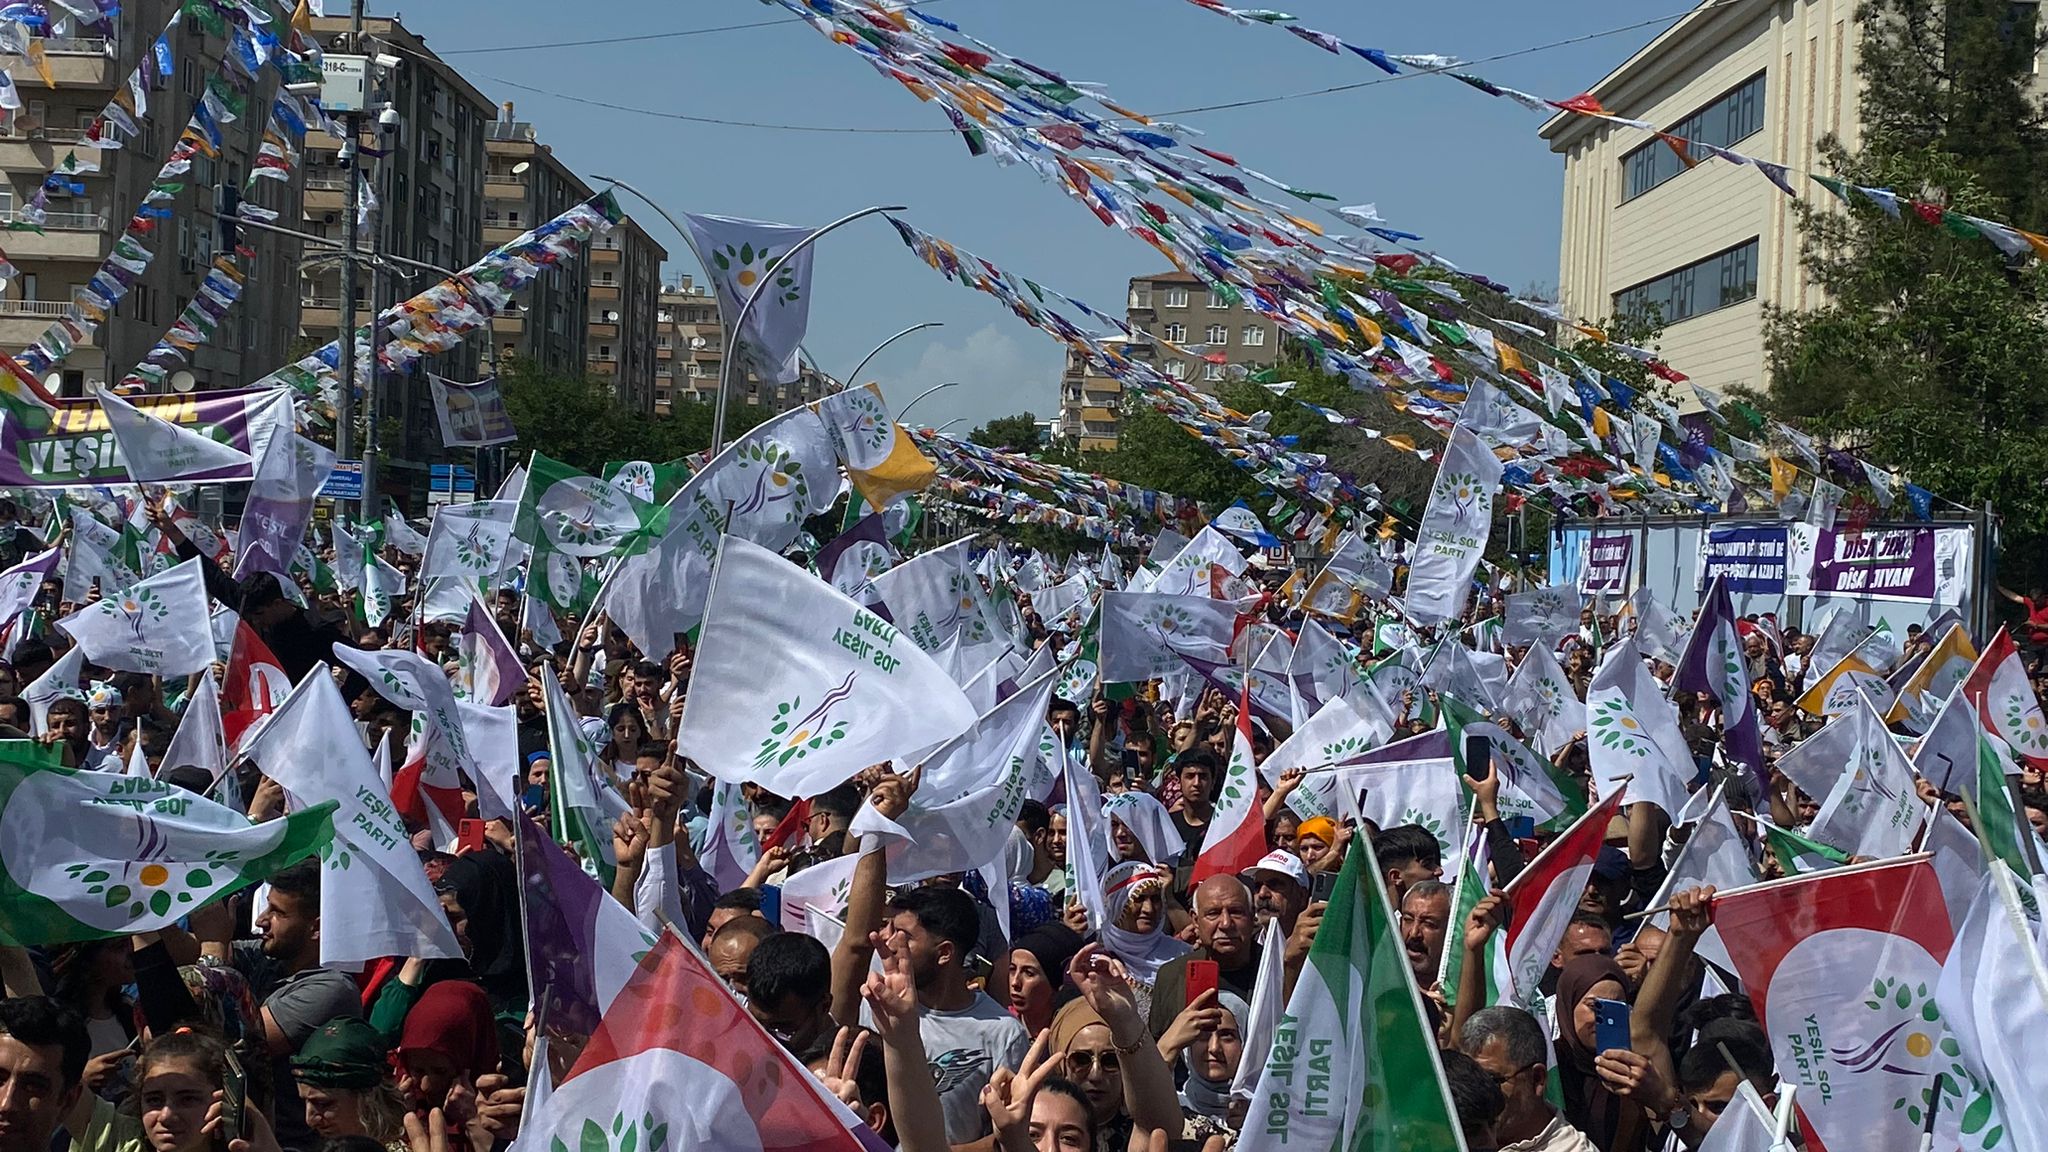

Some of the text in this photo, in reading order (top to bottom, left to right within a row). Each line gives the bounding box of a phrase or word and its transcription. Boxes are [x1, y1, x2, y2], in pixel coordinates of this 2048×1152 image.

[1273, 547, 1282, 557] D
[1433, 544, 1467, 560] PARTİ
[1458, 536, 1480, 549] SOL
[1869, 566, 1915, 589] JIYAN
[355, 784, 393, 825] YEŞİL
[1516, 799, 1534, 810] SOL
[352, 812, 399, 851] PARTİ
[1788, 1033, 1816, 1086] PARTİ
[1804, 1013, 1832, 1106] YEŞİL SOL
